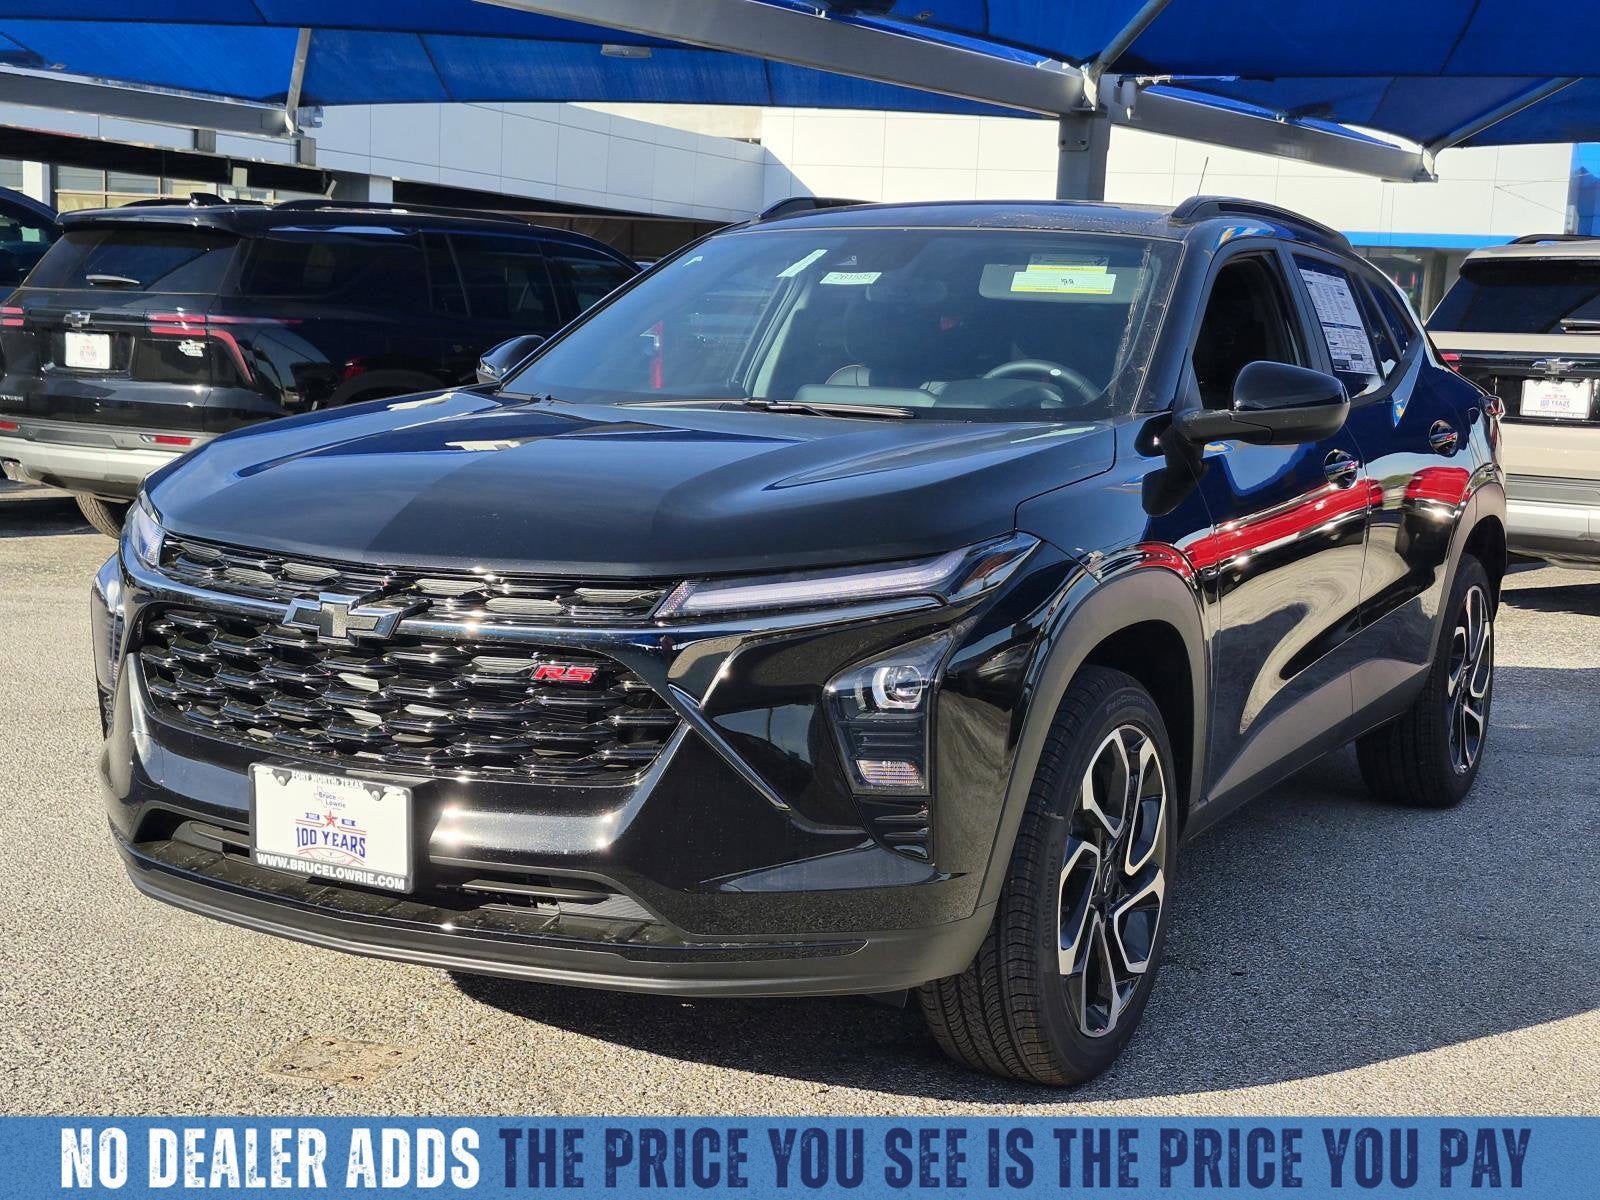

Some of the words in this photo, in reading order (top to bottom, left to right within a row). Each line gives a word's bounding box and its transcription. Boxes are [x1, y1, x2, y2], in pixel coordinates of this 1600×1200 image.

[532, 665, 598, 681] RS
[318, 791, 336, 800] Bruce
[325, 799, 346, 808] Lowrie
[296, 826, 317, 848] 100
[321, 830, 366, 858] YEARS
[256, 852, 405, 890] WWW.BRUCELOWRIE.COM
